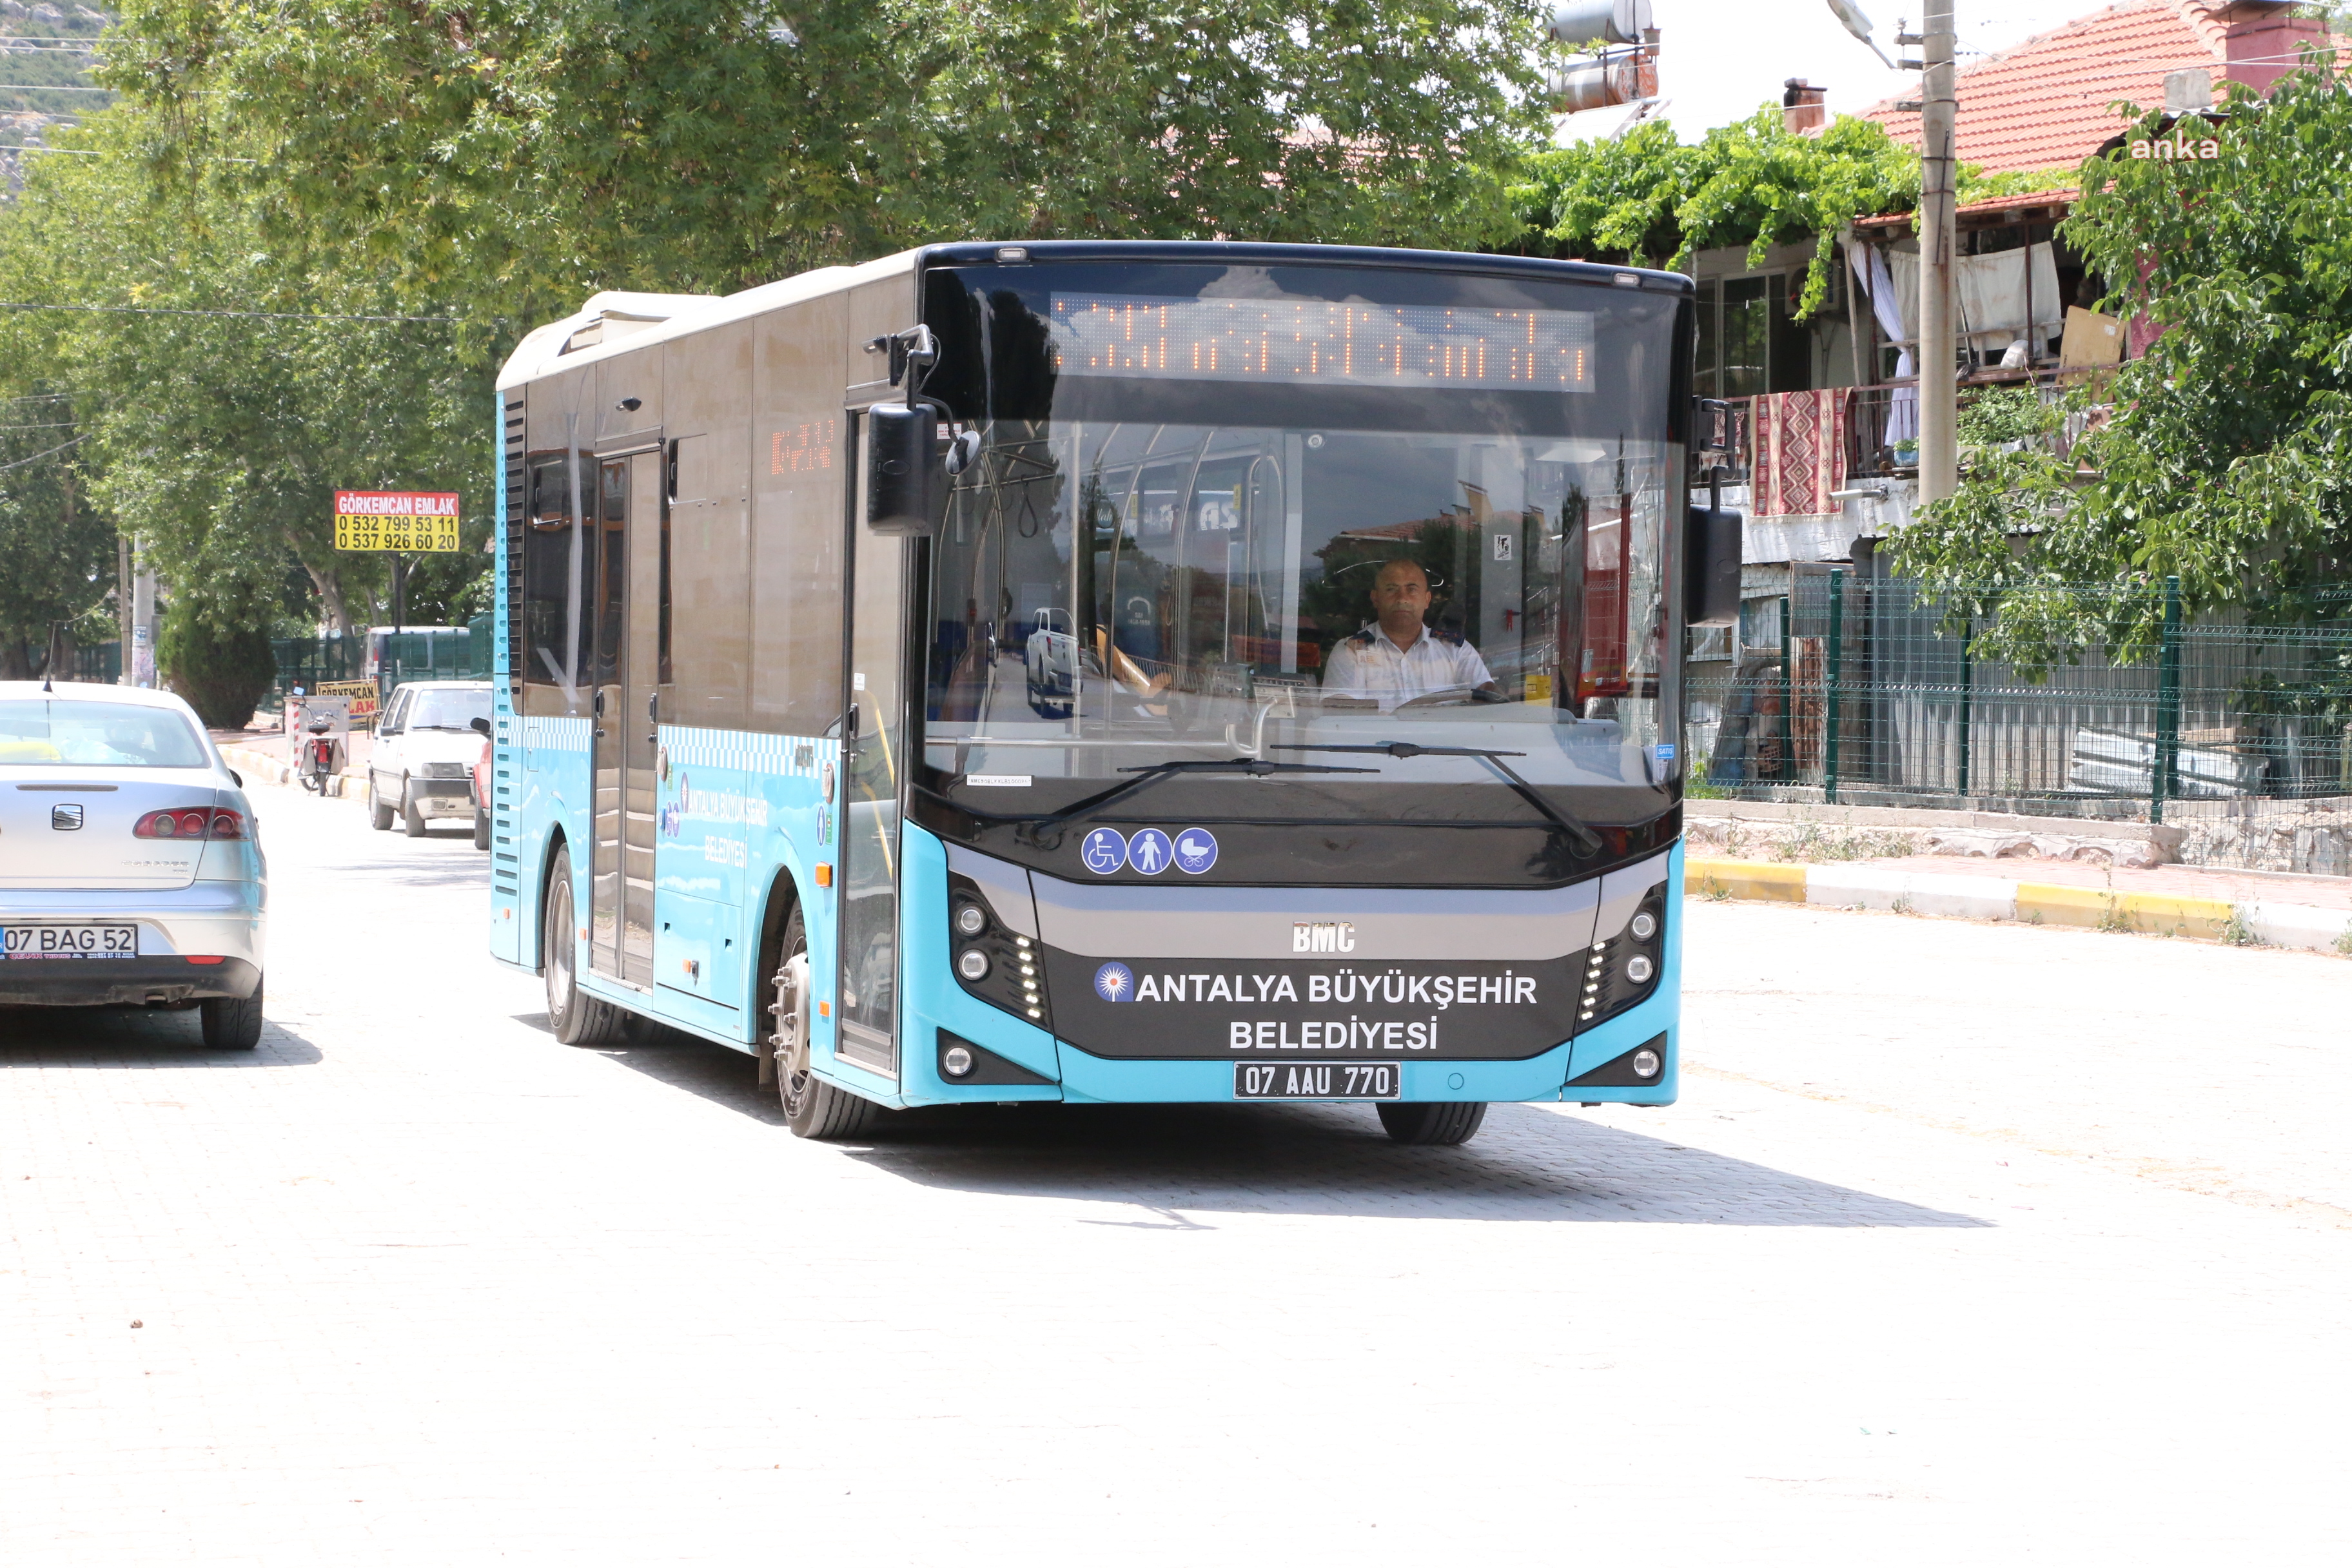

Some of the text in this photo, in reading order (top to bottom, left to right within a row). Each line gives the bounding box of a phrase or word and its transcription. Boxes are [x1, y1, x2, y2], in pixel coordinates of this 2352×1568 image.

[339, 493, 455, 515] GÖRKEMCAN EMLAK
[339, 516, 454, 532] 0 532 799 53 11
[339, 533, 455, 549] 0 537 926 60 20
[349, 701, 375, 713] LAK
[688, 788, 768, 830] ANTALYA BÜYÜKŞEHİR
[705, 832, 747, 868] BELEDİYESİ
[5, 929, 132, 950] 07 BAG 52
[1292, 921, 1355, 952] BMC
[1135, 969, 1537, 1010] ANTALYA BÜYÜKŞEHİR
[1230, 1015, 1437, 1050] BELEDİYESİ
[1246, 1068, 1389, 1095] 07 AAU 770
